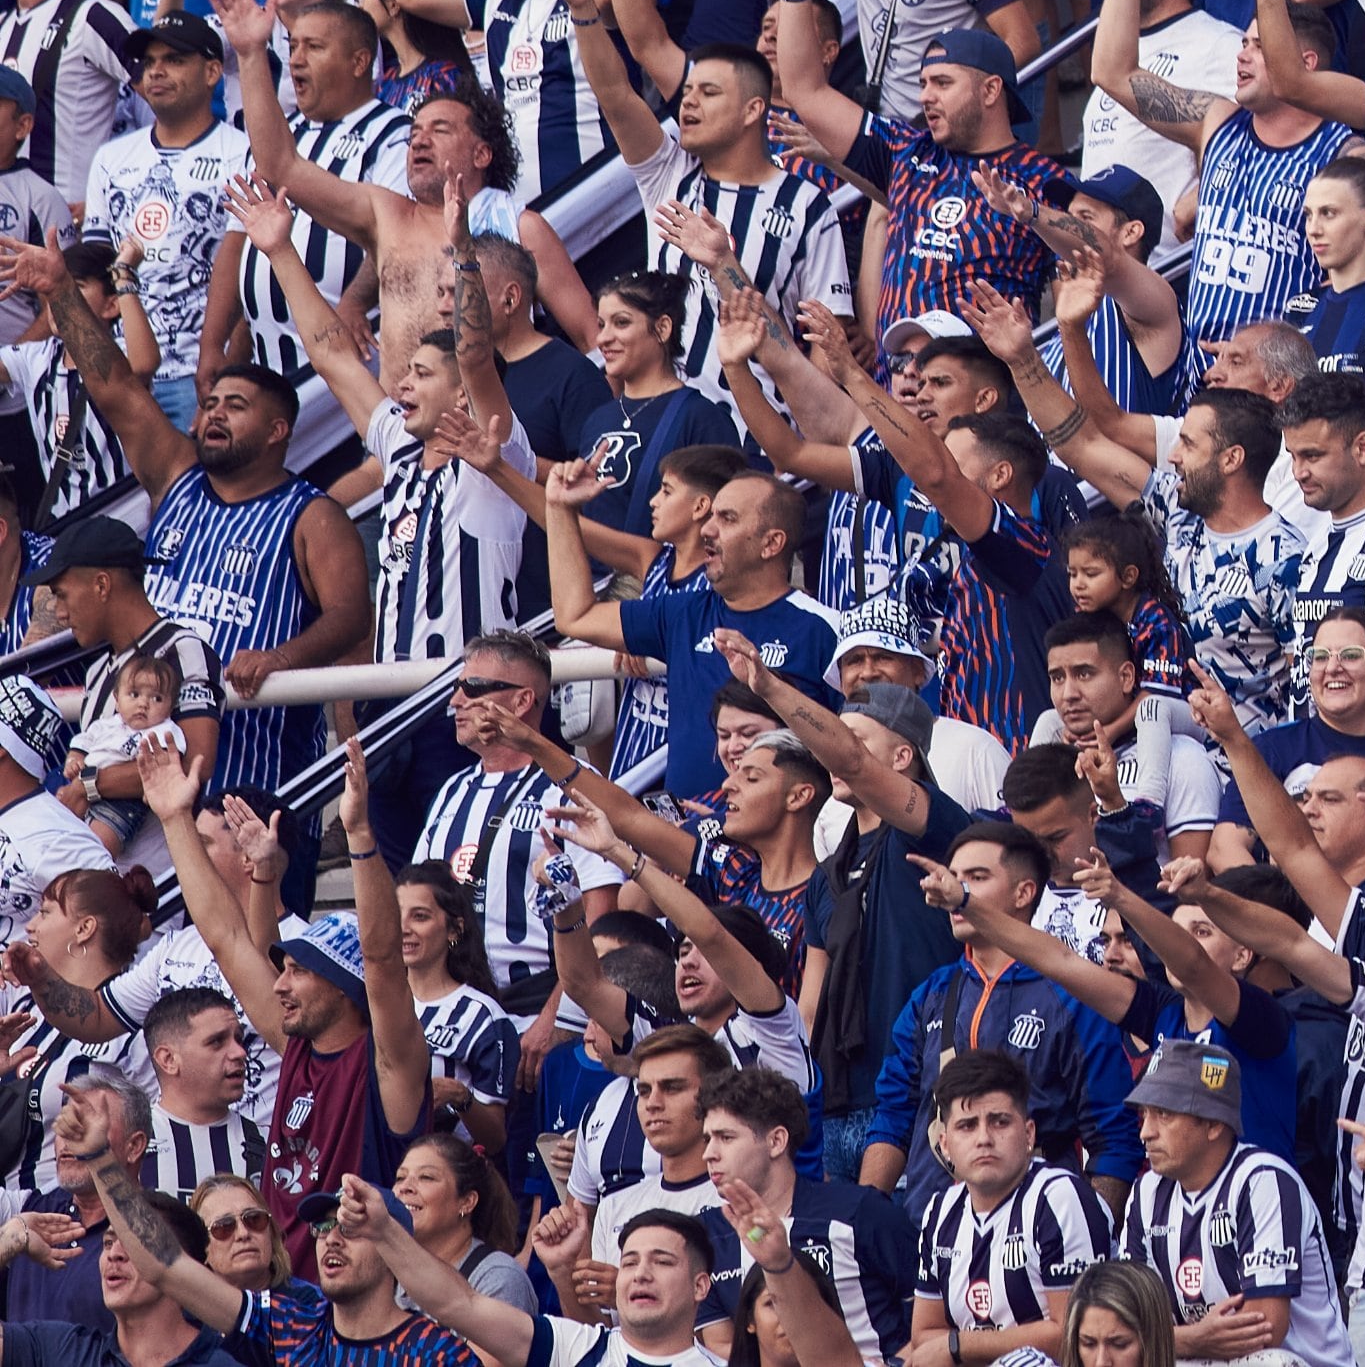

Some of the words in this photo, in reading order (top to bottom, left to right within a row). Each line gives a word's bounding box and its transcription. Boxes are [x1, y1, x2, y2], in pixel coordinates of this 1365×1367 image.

[1091, 117, 1119, 133] ICBC
[915, 230, 961, 249] ICBC
[145, 248, 170, 263] BC
[909, 247, 954, 262] Argentina
[1197, 238, 1272, 294] 99
[831, 282, 851, 295] Rii
[1141, 699, 1160, 722] CAT
[1244, 1247, 1298, 1273] vittal
